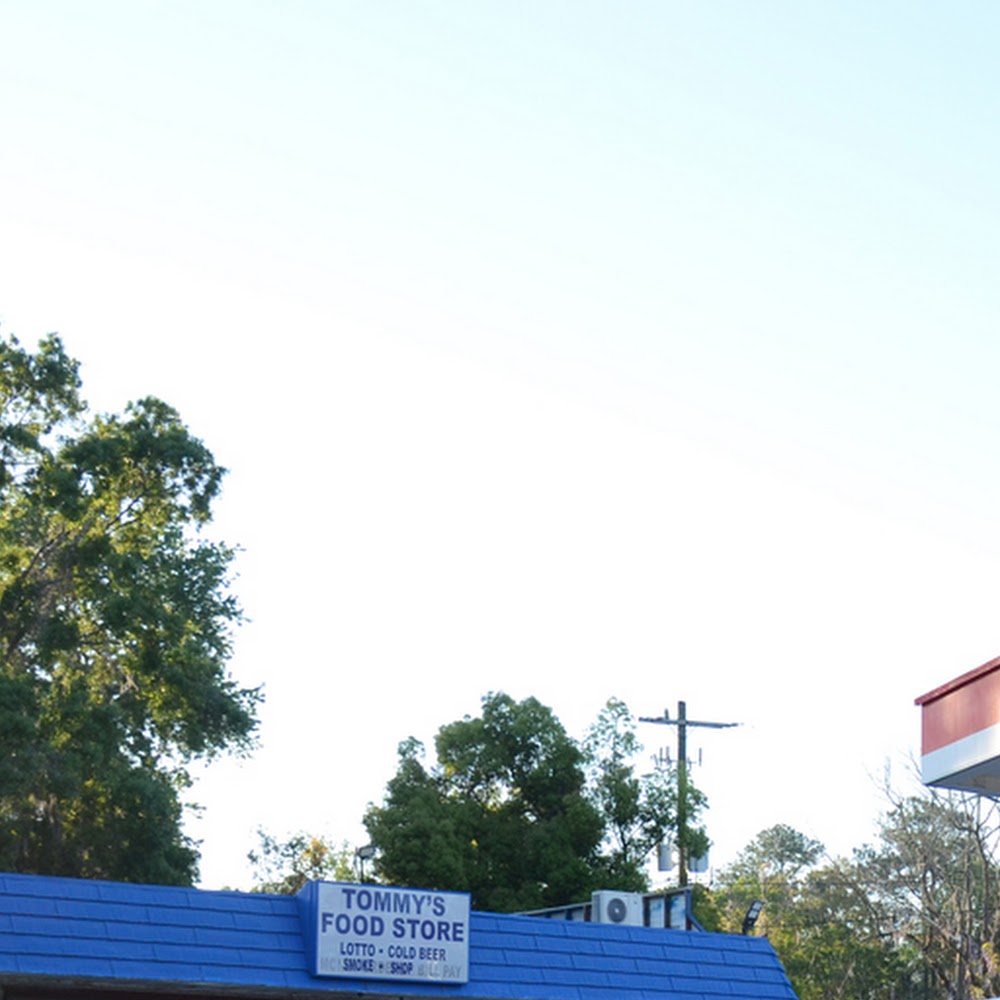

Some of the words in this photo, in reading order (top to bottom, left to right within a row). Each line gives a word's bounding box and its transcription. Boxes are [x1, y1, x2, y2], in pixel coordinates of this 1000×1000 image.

[342, 888, 446, 917] TOMMY'S
[321, 912, 385, 937] FOOD
[392, 917, 464, 942] STORE
[340, 941, 376, 957] LOTTO
[387, 945, 417, 960] COLD
[419, 947, 446, 961] BEER
[342, 957, 374, 972] SMOKE
[390, 961, 414, 975] SHOP
